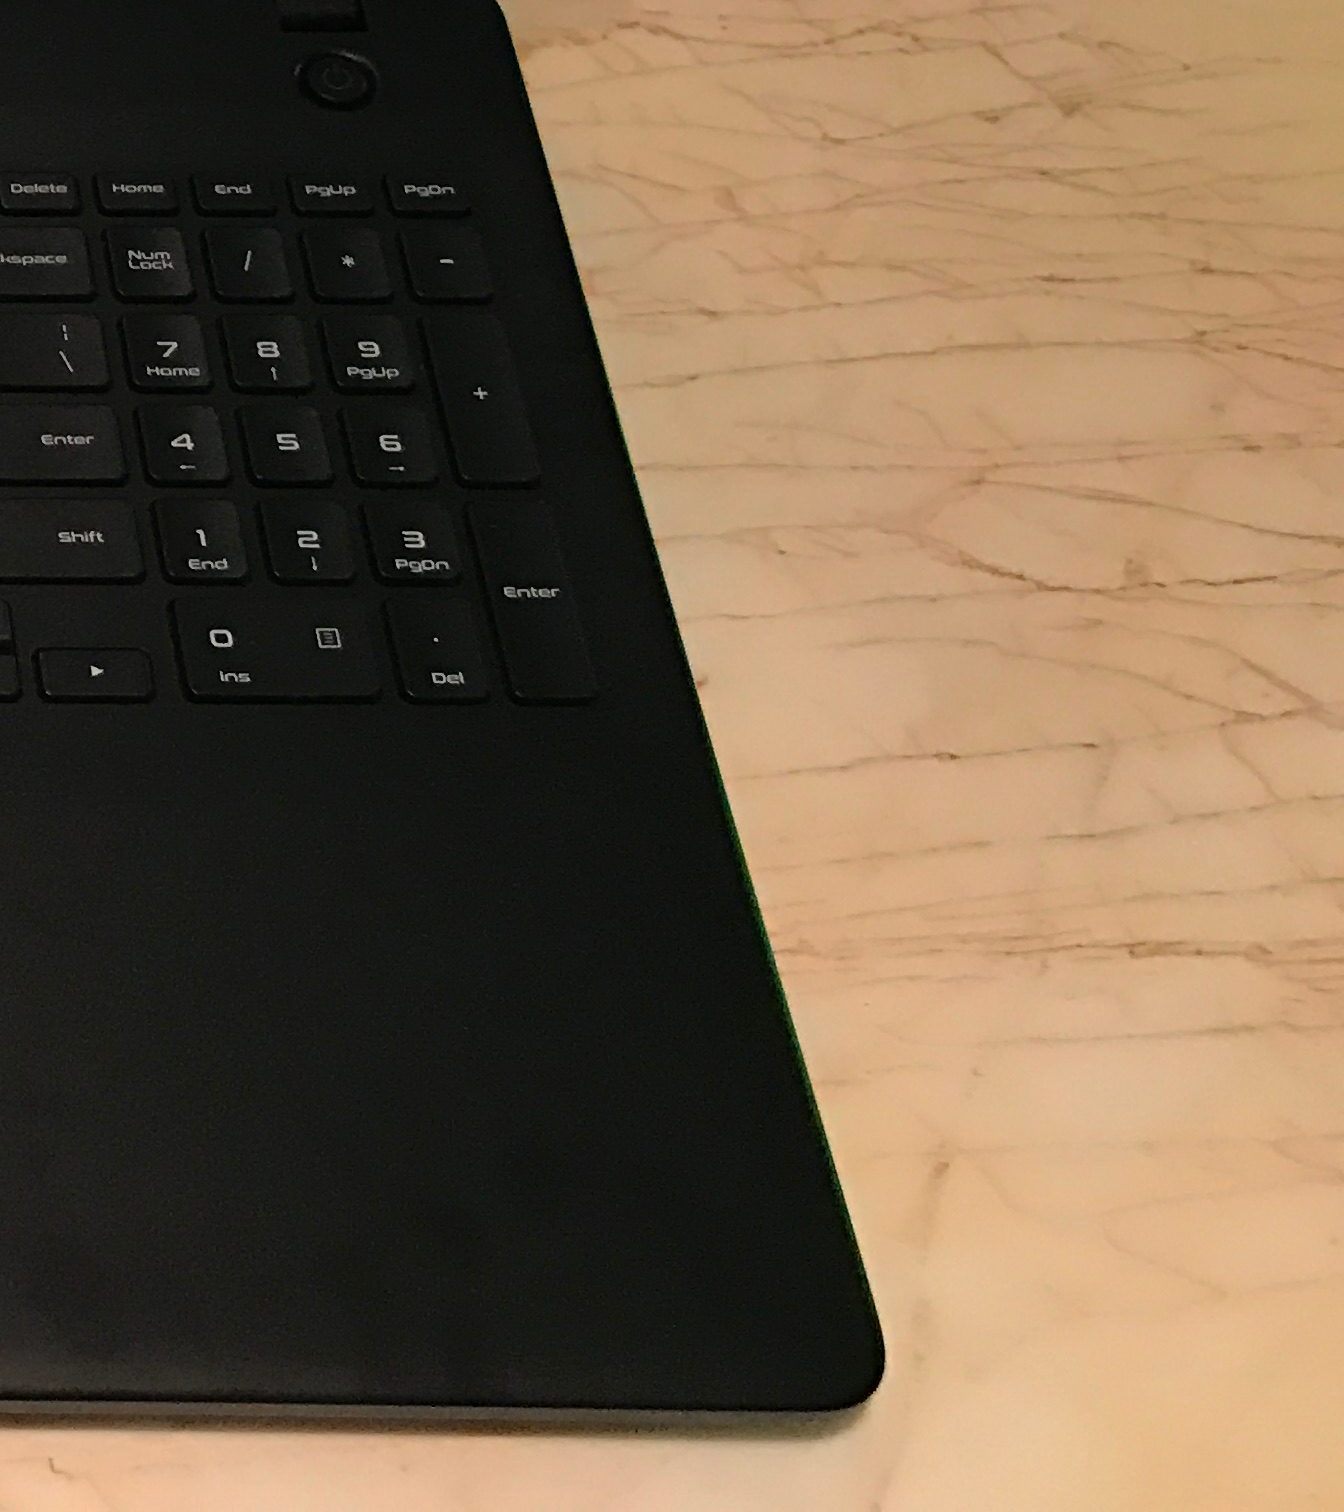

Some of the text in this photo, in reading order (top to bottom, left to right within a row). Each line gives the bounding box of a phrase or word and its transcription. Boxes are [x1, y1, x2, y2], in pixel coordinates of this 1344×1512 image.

[10, 183, 68, 194] Delete
[112, 183, 165, 194] Home
[214, 183, 252, 195] End
[304, 184, 357, 197] PgUp
[403, 184, 456, 197] PgDn
[128, 250, 171, 260] Num
[128, 259, 175, 270] Lock
[156, 341, 179, 358] 7
[256, 341, 281, 358] 8
[357, 341, 381, 358] 9
[146, 366, 201, 377] Home
[346, 366, 400, 380] PgUp
[40, 434, 95, 446] Enter
[170, 433, 195, 451] 4
[276, 433, 300, 451] 5
[378, 434, 402, 452] 6
[57, 530, 105, 543] Shift
[195, 528, 207, 547] 1
[296, 530, 321, 549] 2
[401, 530, 426, 549] 3
[188, 557, 229, 571] End
[394, 558, 450, 573] PgDn
[503, 586, 560, 599] Enter
[219, 670, 251, 683] Ins
[431, 671, 465, 685] Del
